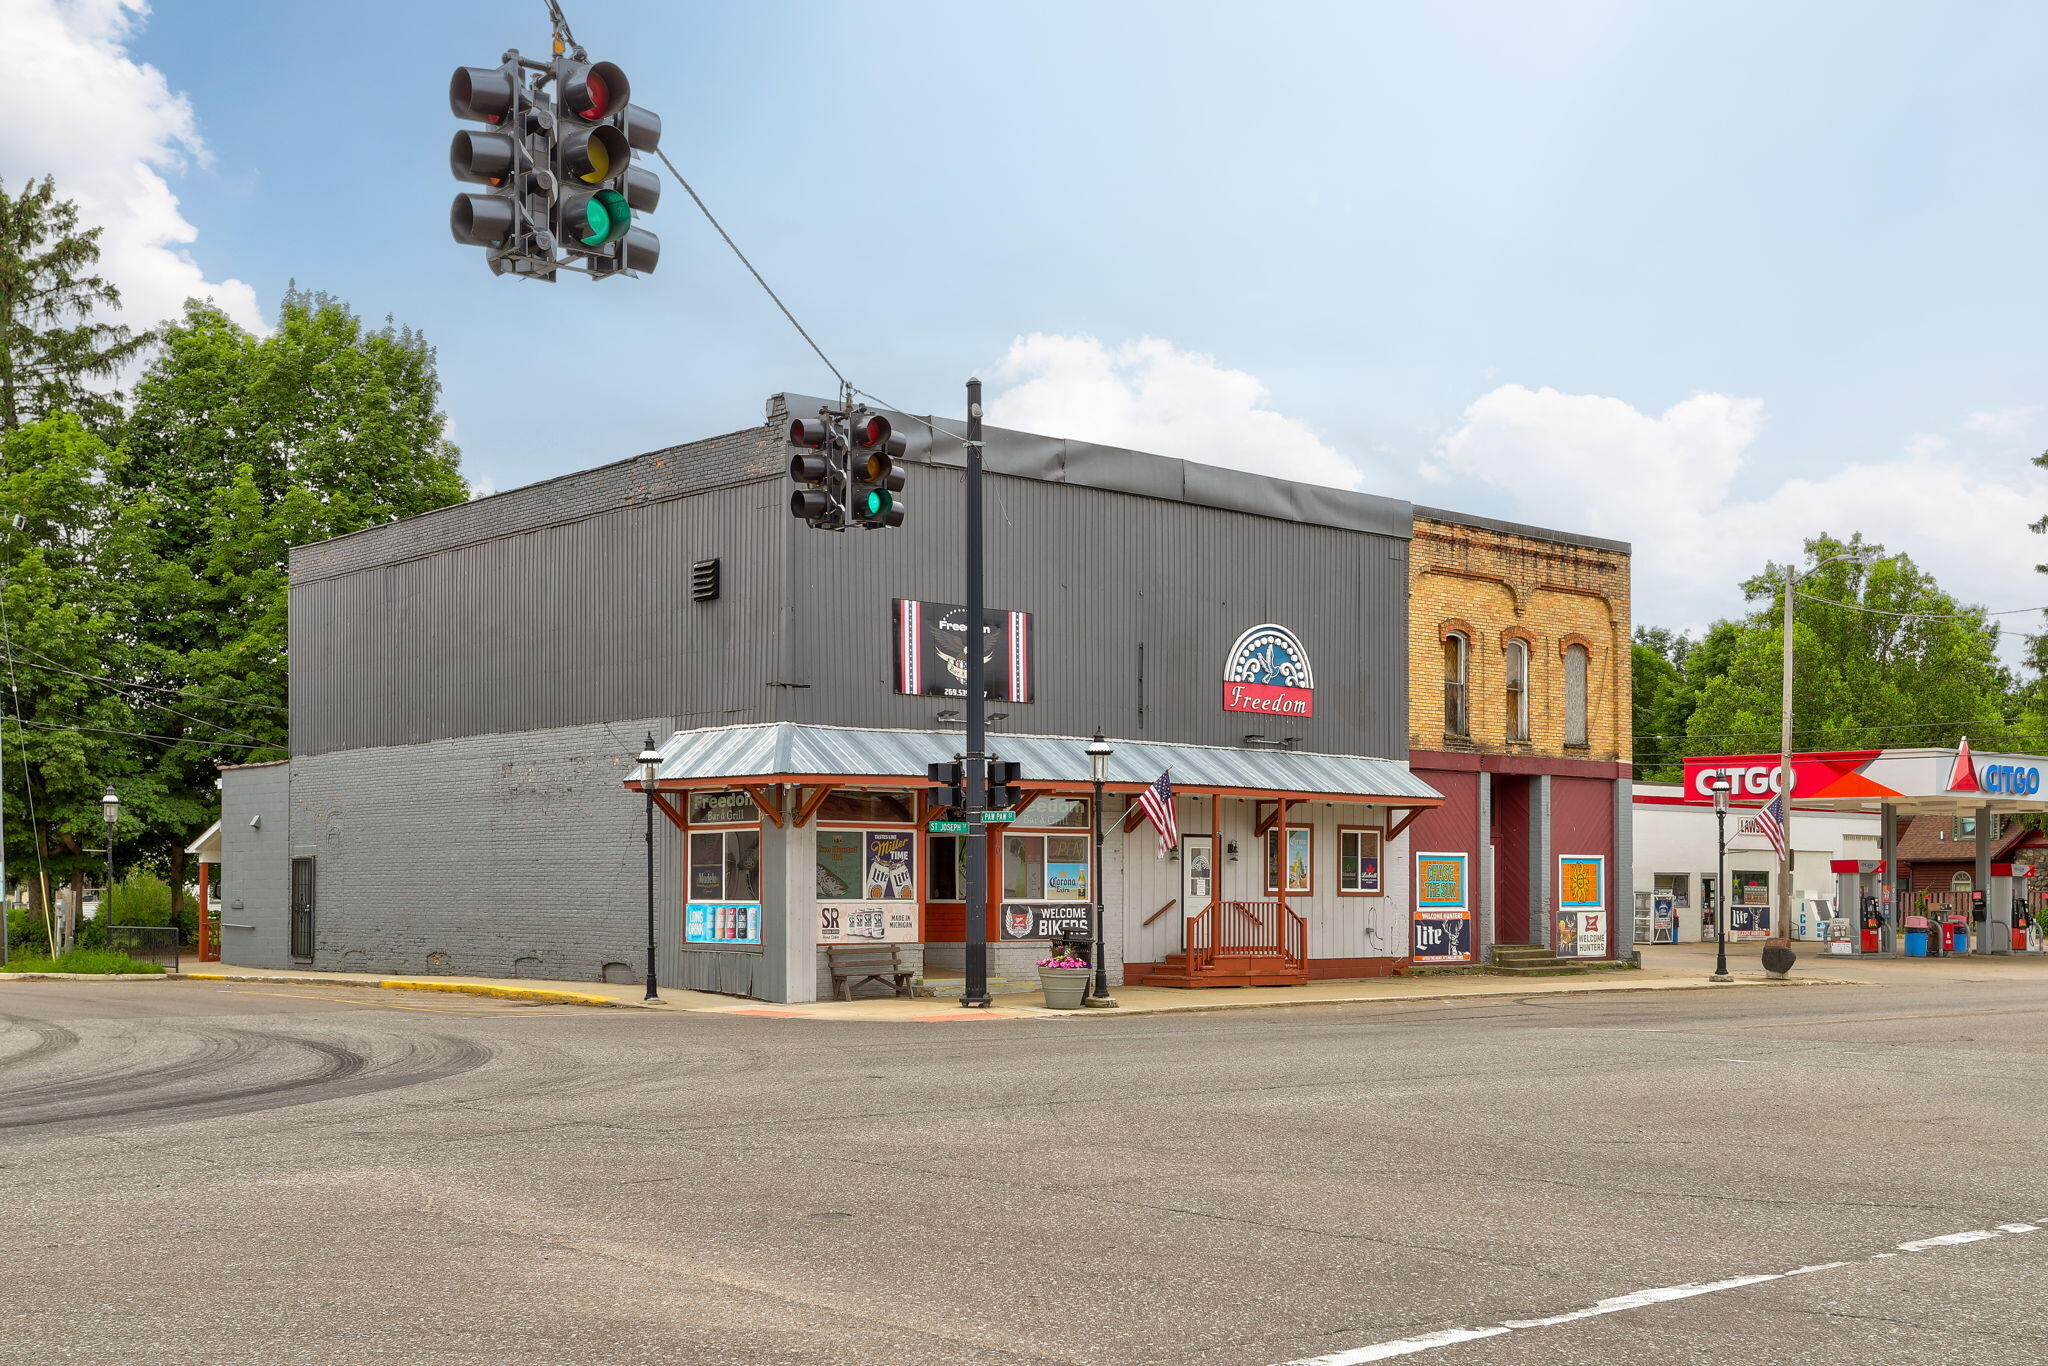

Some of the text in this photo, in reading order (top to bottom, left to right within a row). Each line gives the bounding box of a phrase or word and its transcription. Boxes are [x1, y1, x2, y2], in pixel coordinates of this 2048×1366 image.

[1230, 686, 1306, 714] Freedom
[1985, 764, 2040, 795] CITGO
[707, 811, 720, 821] Bar
[727, 809, 744, 820] Grill
[984, 813, 995, 821] PAW
[996, 813, 1008, 821] PAW
[930, 823, 938, 831] ST
[940, 823, 961, 832] JOSEPH
[871, 839, 909, 857] Miller
[890, 850, 909, 860] TIME
[872, 868, 889, 883] Lite
[1426, 864, 1455, 881] CHASE
[1049, 876, 1076, 888] Corona
[821, 907, 840, 929] SR
[1041, 907, 1087, 918] WELCOME
[1732, 909, 1749, 928] Lite
[889, 921, 912, 929] MICHIGAN
[1415, 924, 1442, 951] Lite
[1578, 934, 1605, 943] WELCOME
[1579, 943, 1605, 951] HUNTERS
